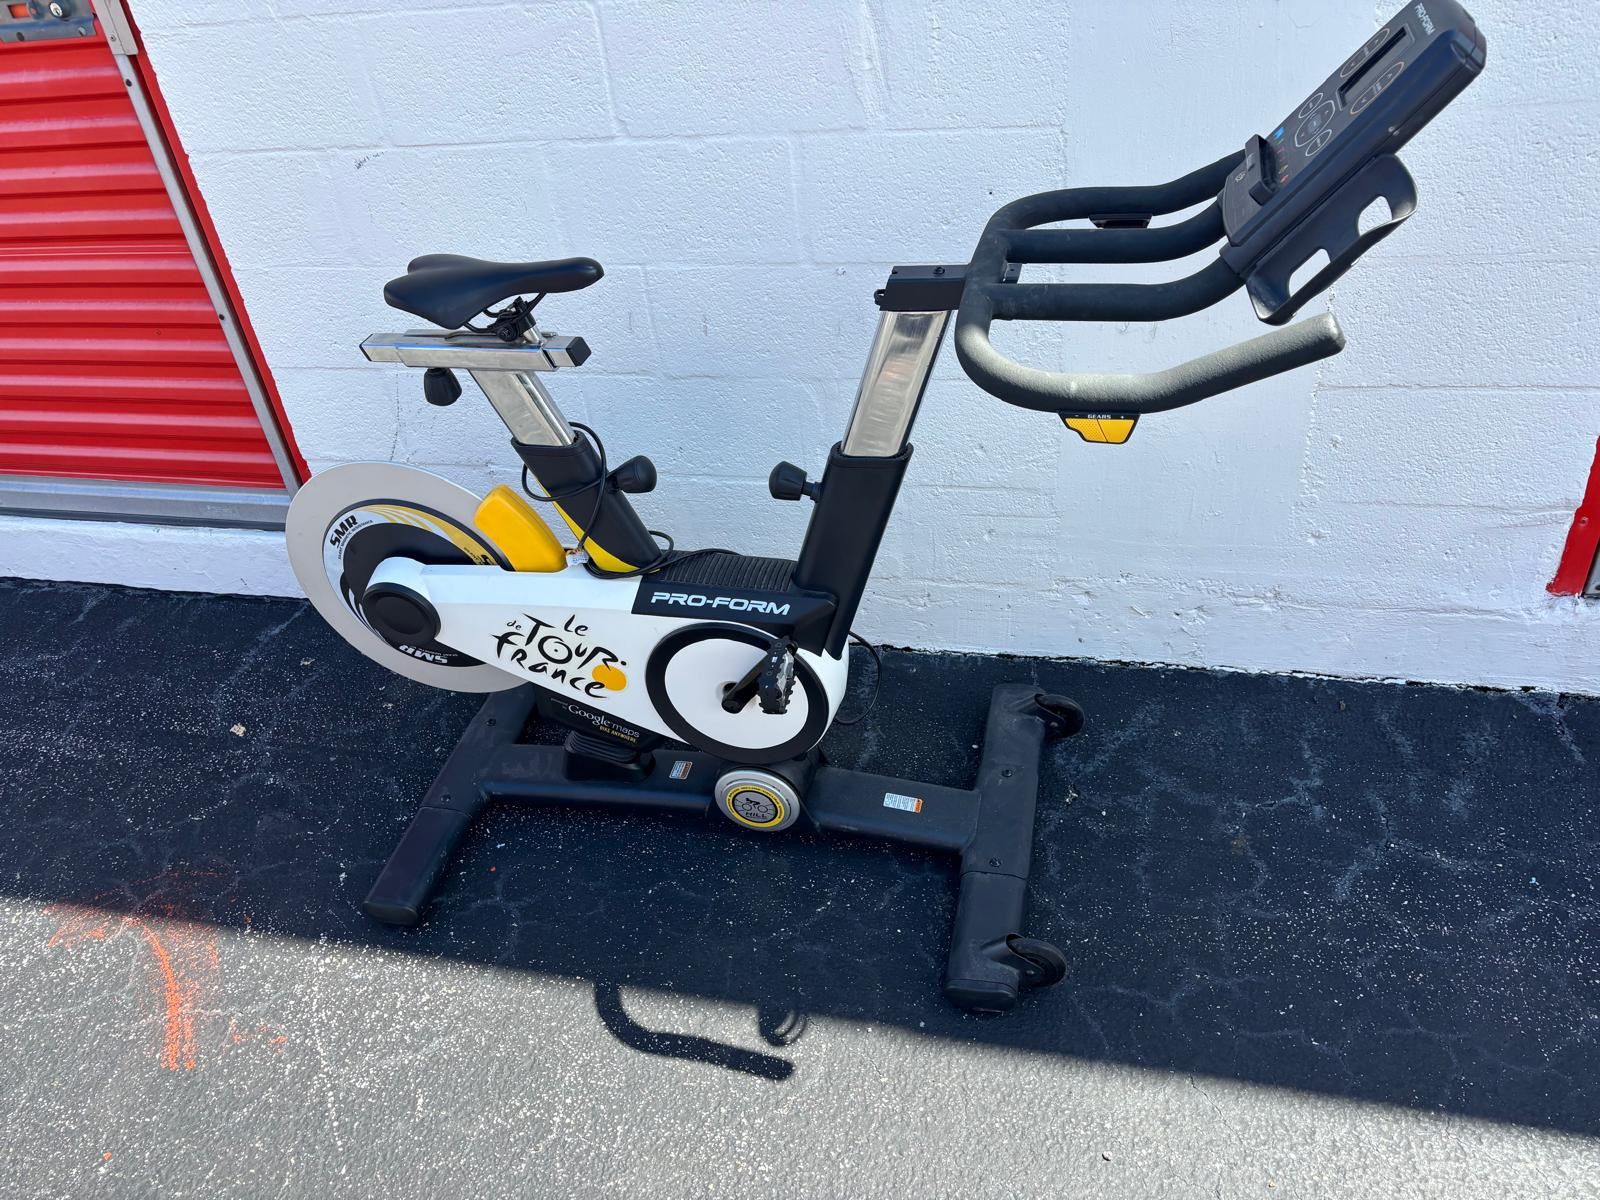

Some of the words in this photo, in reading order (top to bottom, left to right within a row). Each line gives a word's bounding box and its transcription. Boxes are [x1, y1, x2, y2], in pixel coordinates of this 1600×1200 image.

[330, 515, 358, 549] SMR
[650, 591, 791, 616] PRO-FORM
[506, 620, 522, 631] de
[568, 704, 611, 726] Google
[612, 723, 640, 738] maps
